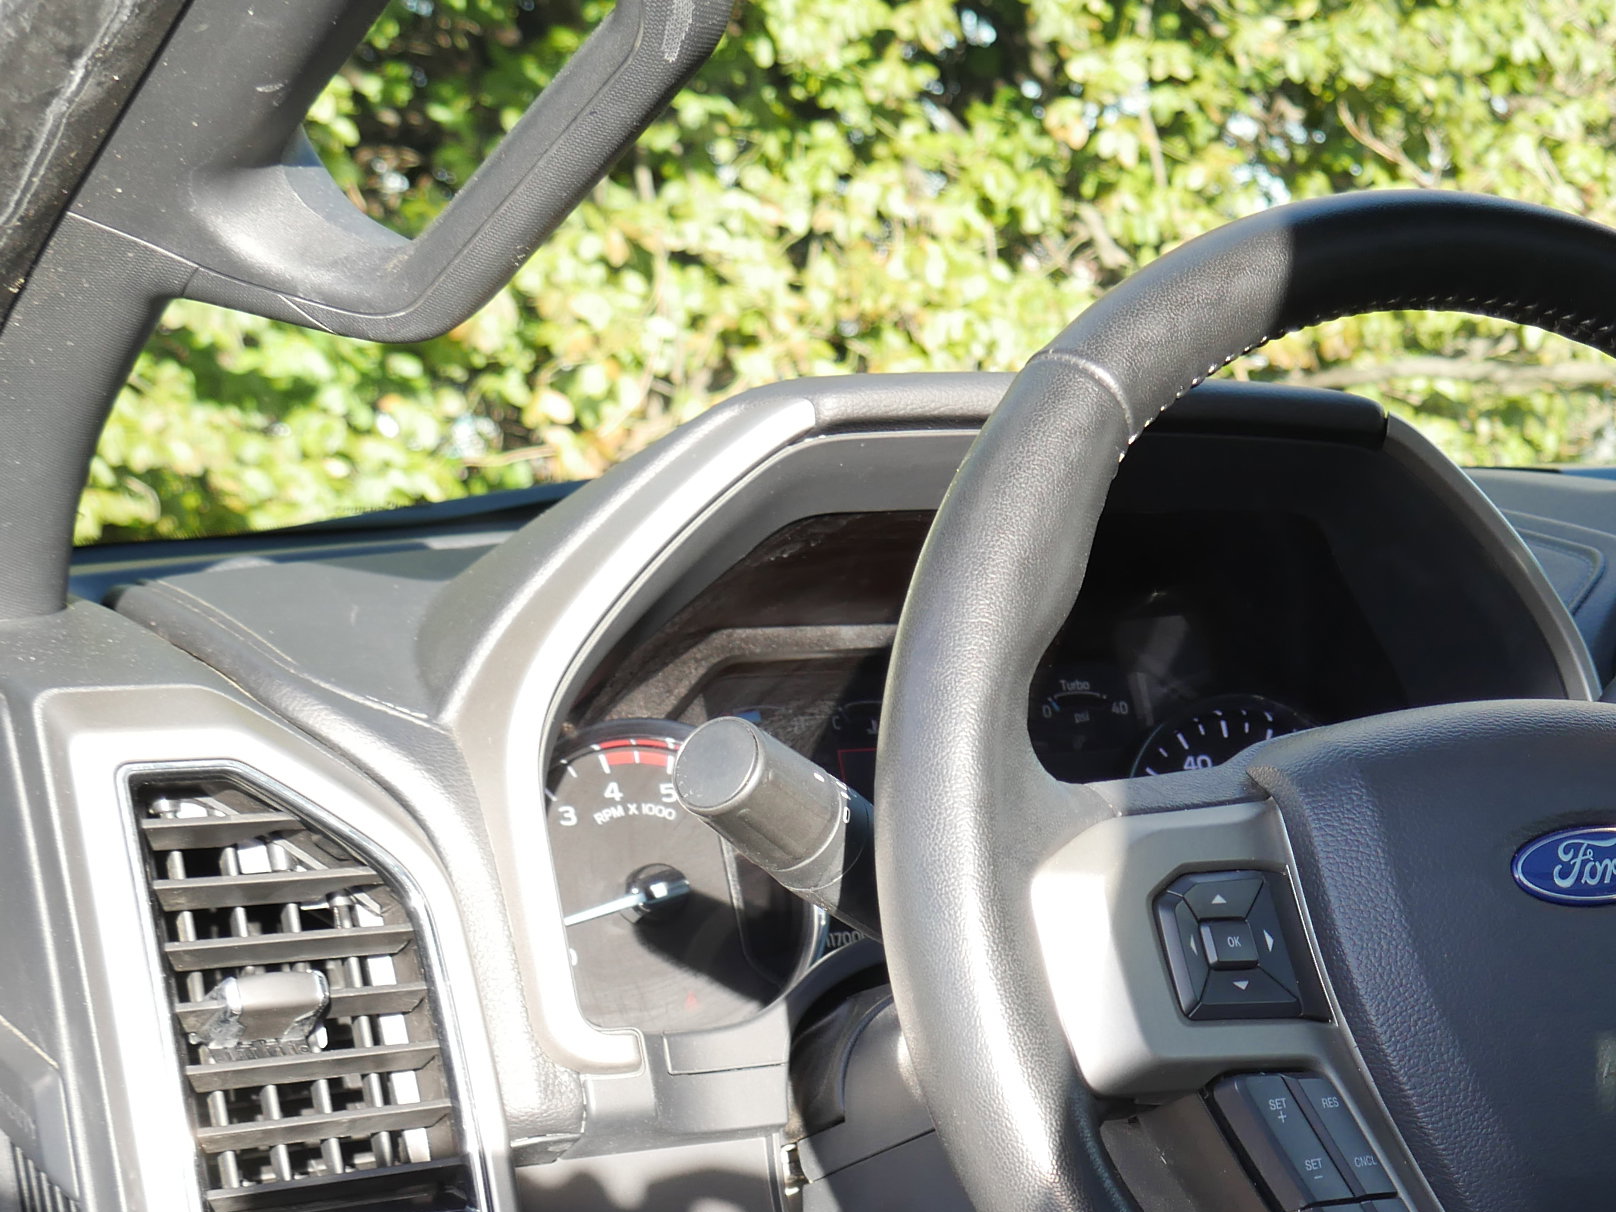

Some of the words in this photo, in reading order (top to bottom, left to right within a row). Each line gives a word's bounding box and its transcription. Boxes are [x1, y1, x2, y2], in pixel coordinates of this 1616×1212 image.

[1059, 679, 1091, 690] Turbo
[604, 782, 623, 801] 4
[659, 783, 679, 802] 5
[558, 806, 578, 826] 3
[593, 803, 625, 825] RPM
[642, 803, 677, 820] 1000
[1227, 935, 1242, 948] OK
[1269, 1098, 1286, 1111] SET
[1322, 1097, 1340, 1109] RES
[1304, 1158, 1323, 1171] SET
[1354, 1155, 1378, 1168] CNCL
